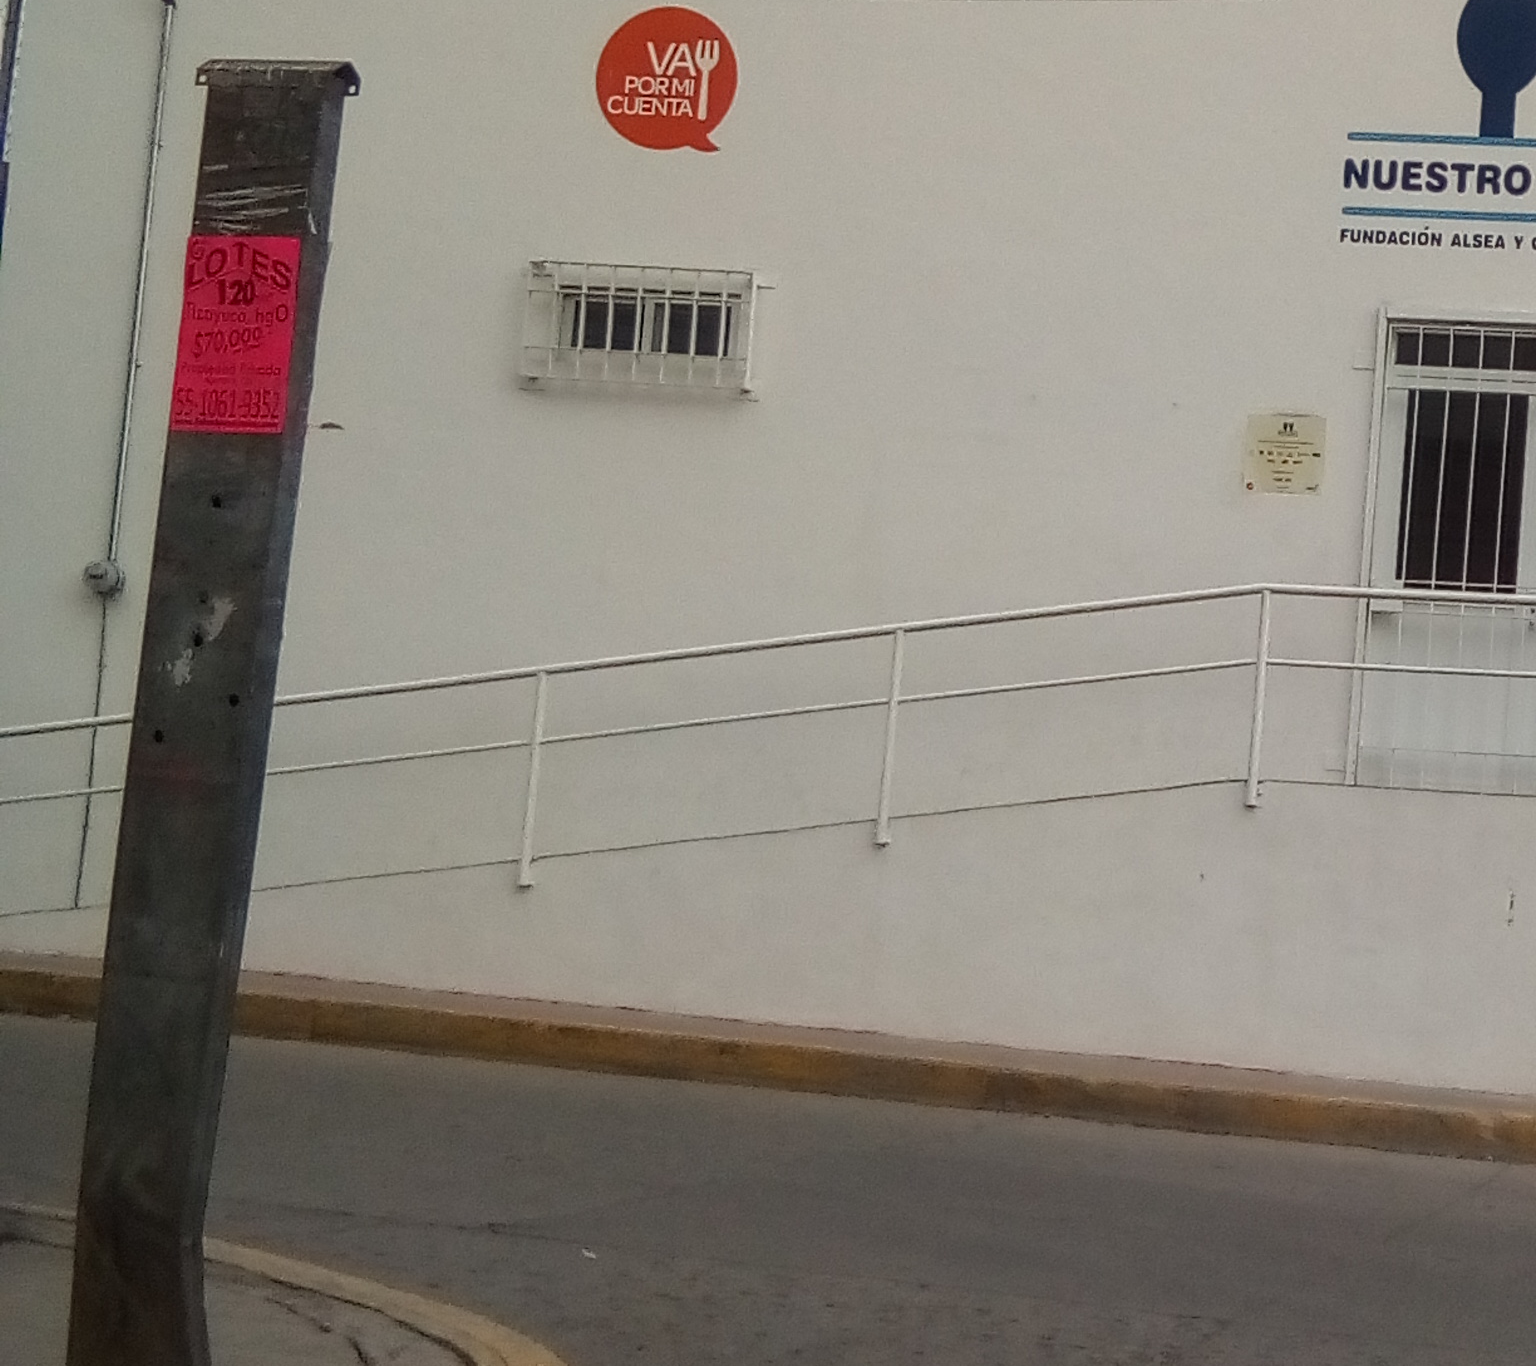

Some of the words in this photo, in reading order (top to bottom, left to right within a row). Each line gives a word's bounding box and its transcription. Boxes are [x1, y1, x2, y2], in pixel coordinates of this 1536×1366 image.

[647, 41, 697, 76] VA
[624, 76, 668, 95] POR
[672, 78, 695, 96] MI
[607, 95, 693, 117] CUENTA
[1343, 157, 1532, 196] NUESTRO
[1338, 225, 1443, 248] FUNDACIÓN
[1450, 233, 1506, 251] ALSEA
[1514, 235, 1524, 251] Y
[187, 241, 292, 291] LOTES
[217, 278, 257, 306] 120
